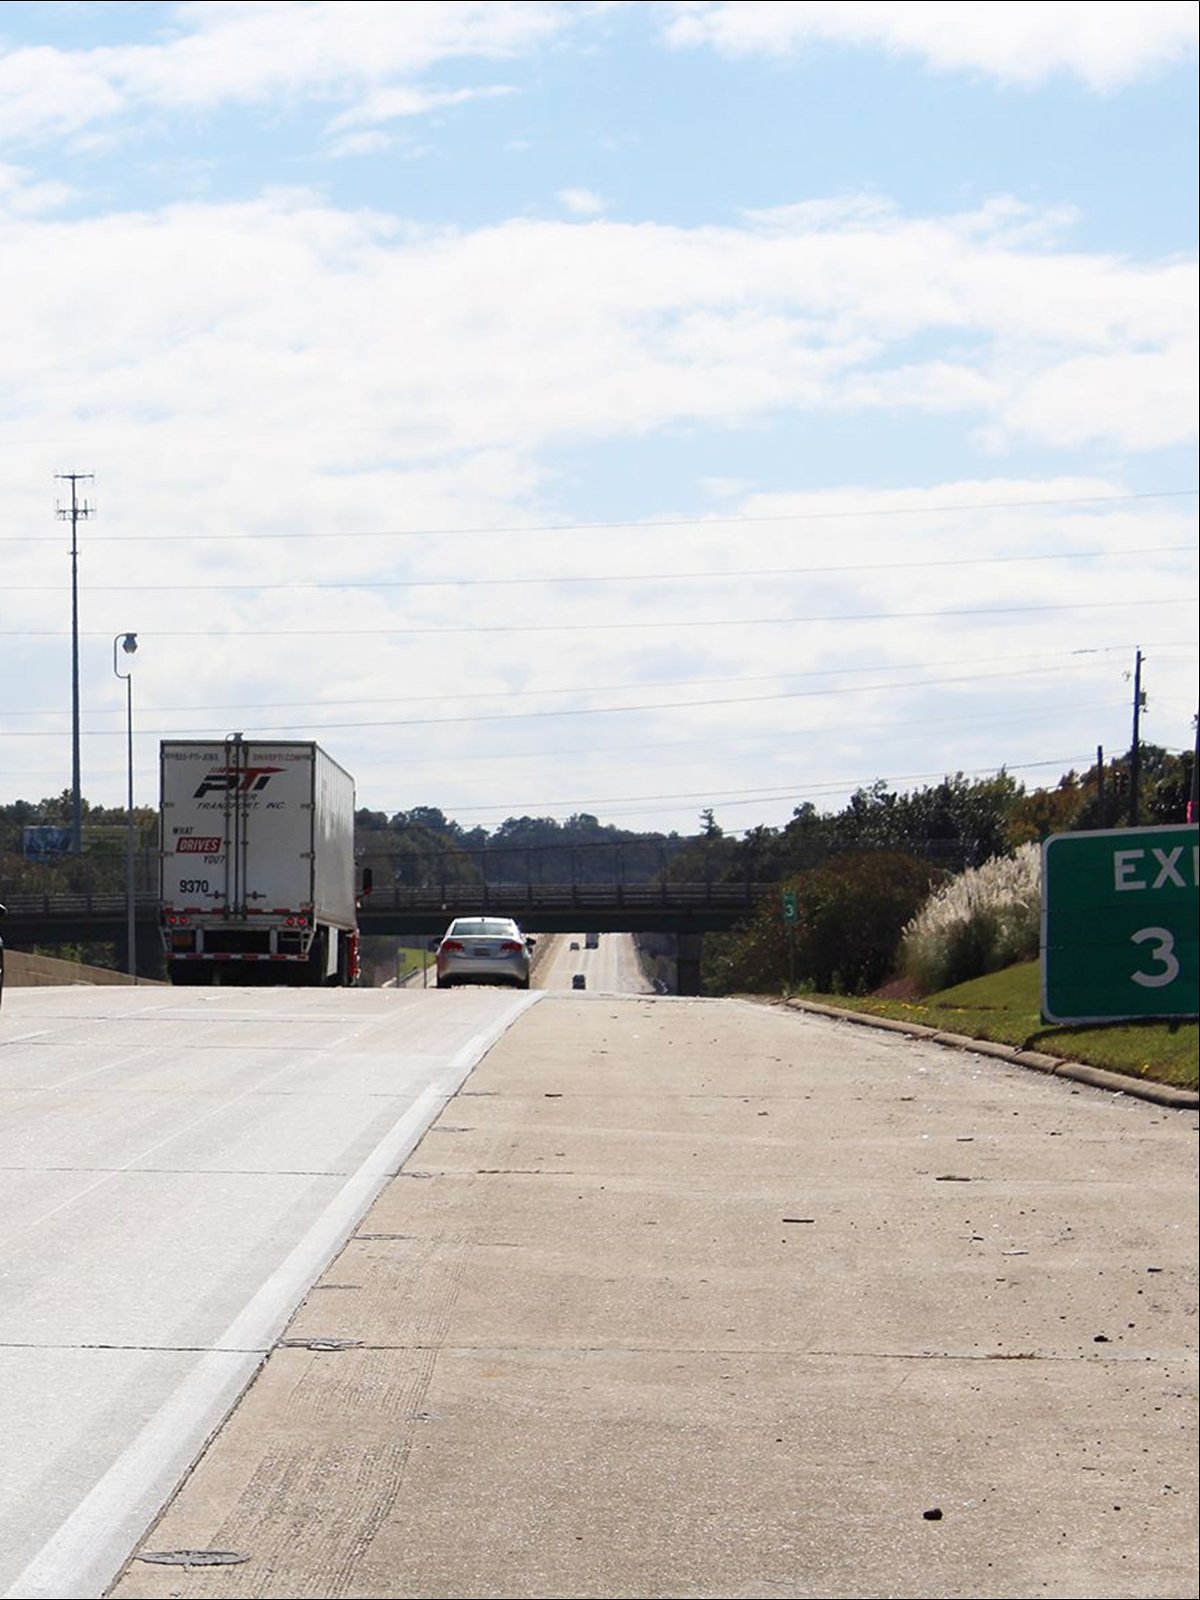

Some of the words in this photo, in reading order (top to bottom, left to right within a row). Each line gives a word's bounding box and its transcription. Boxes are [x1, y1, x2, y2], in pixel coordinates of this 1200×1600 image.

[173, 826, 193, 835] WHAT
[179, 838, 219, 851] DRIVES
[203, 855, 226, 864] YOU?
[180, 879, 209, 893] 9370
[786, 904, 794, 917] 3
[1130, 926, 1180, 988] 3
